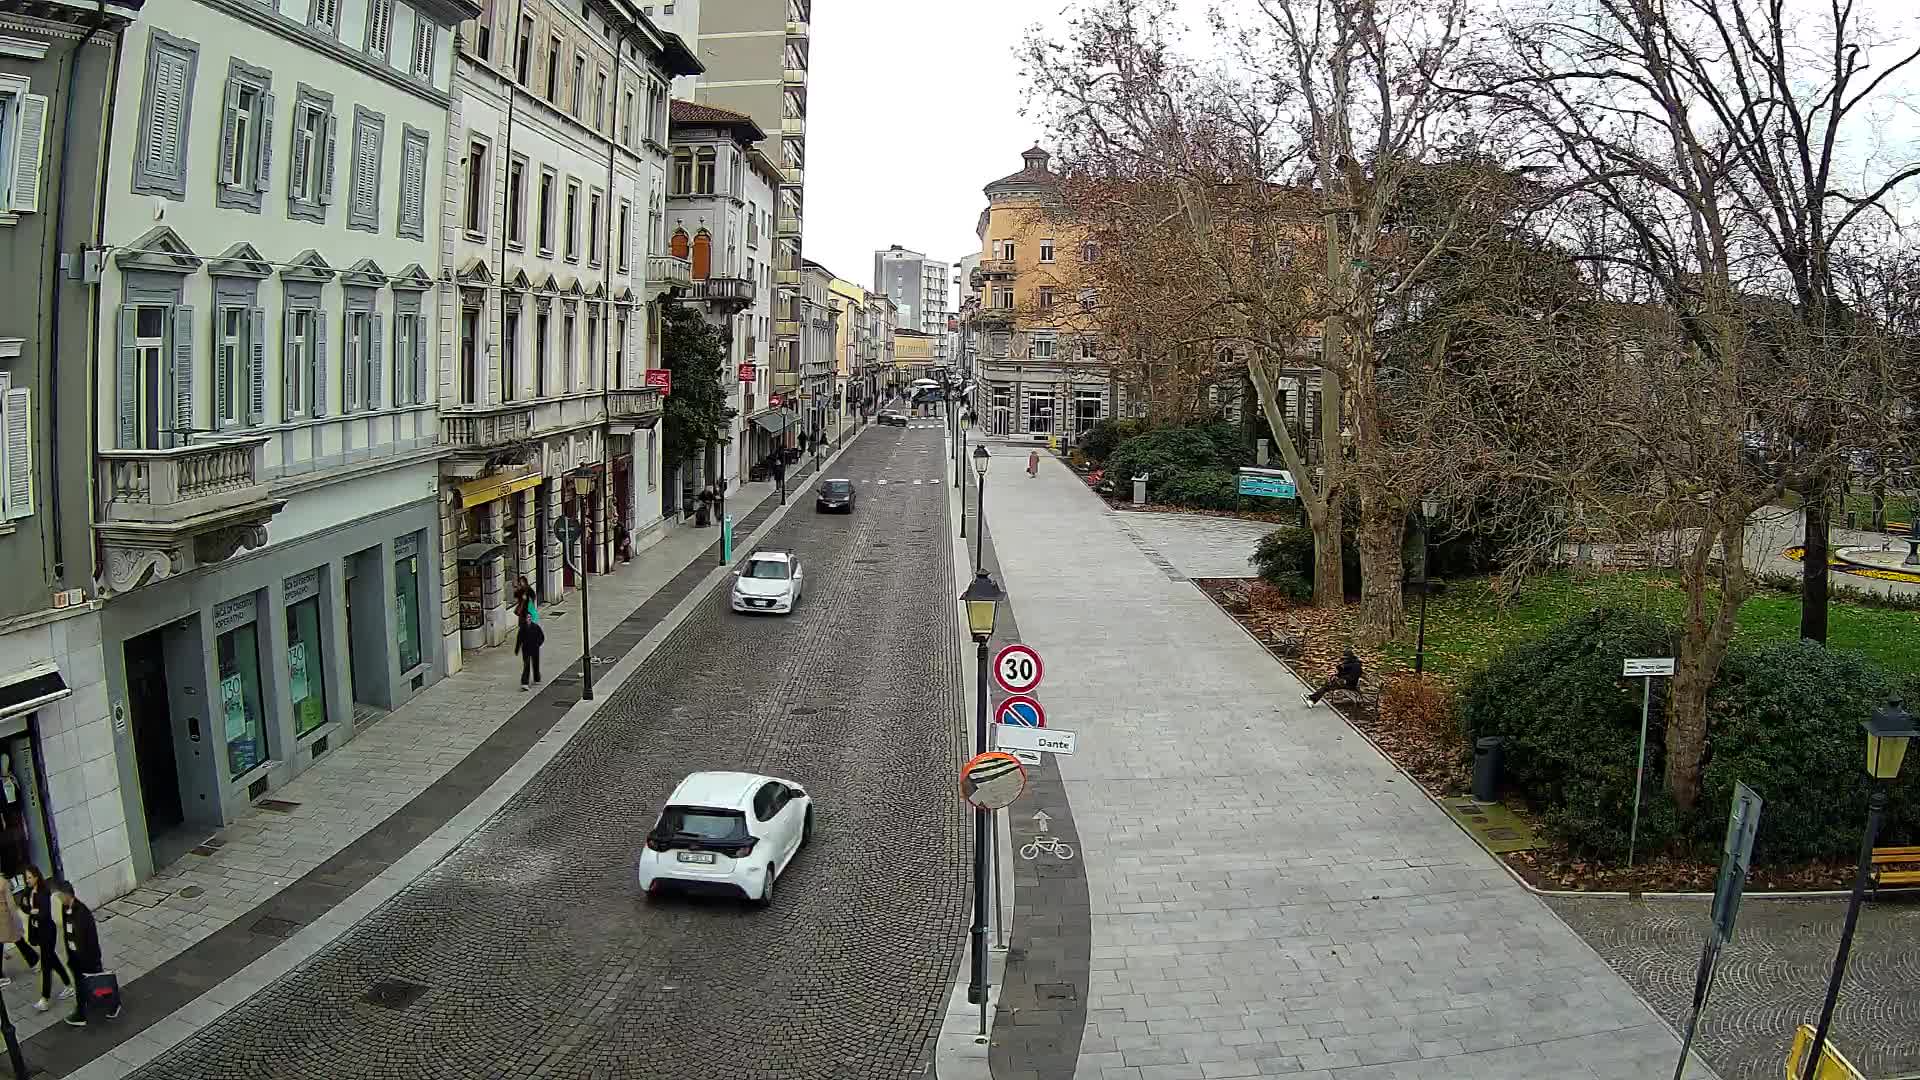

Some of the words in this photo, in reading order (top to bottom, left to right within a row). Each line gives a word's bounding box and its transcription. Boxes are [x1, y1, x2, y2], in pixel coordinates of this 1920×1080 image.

[1005, 659, 1033, 680] 30
[222, 678, 240, 700] 130
[1039, 738, 1070, 748] Dante
